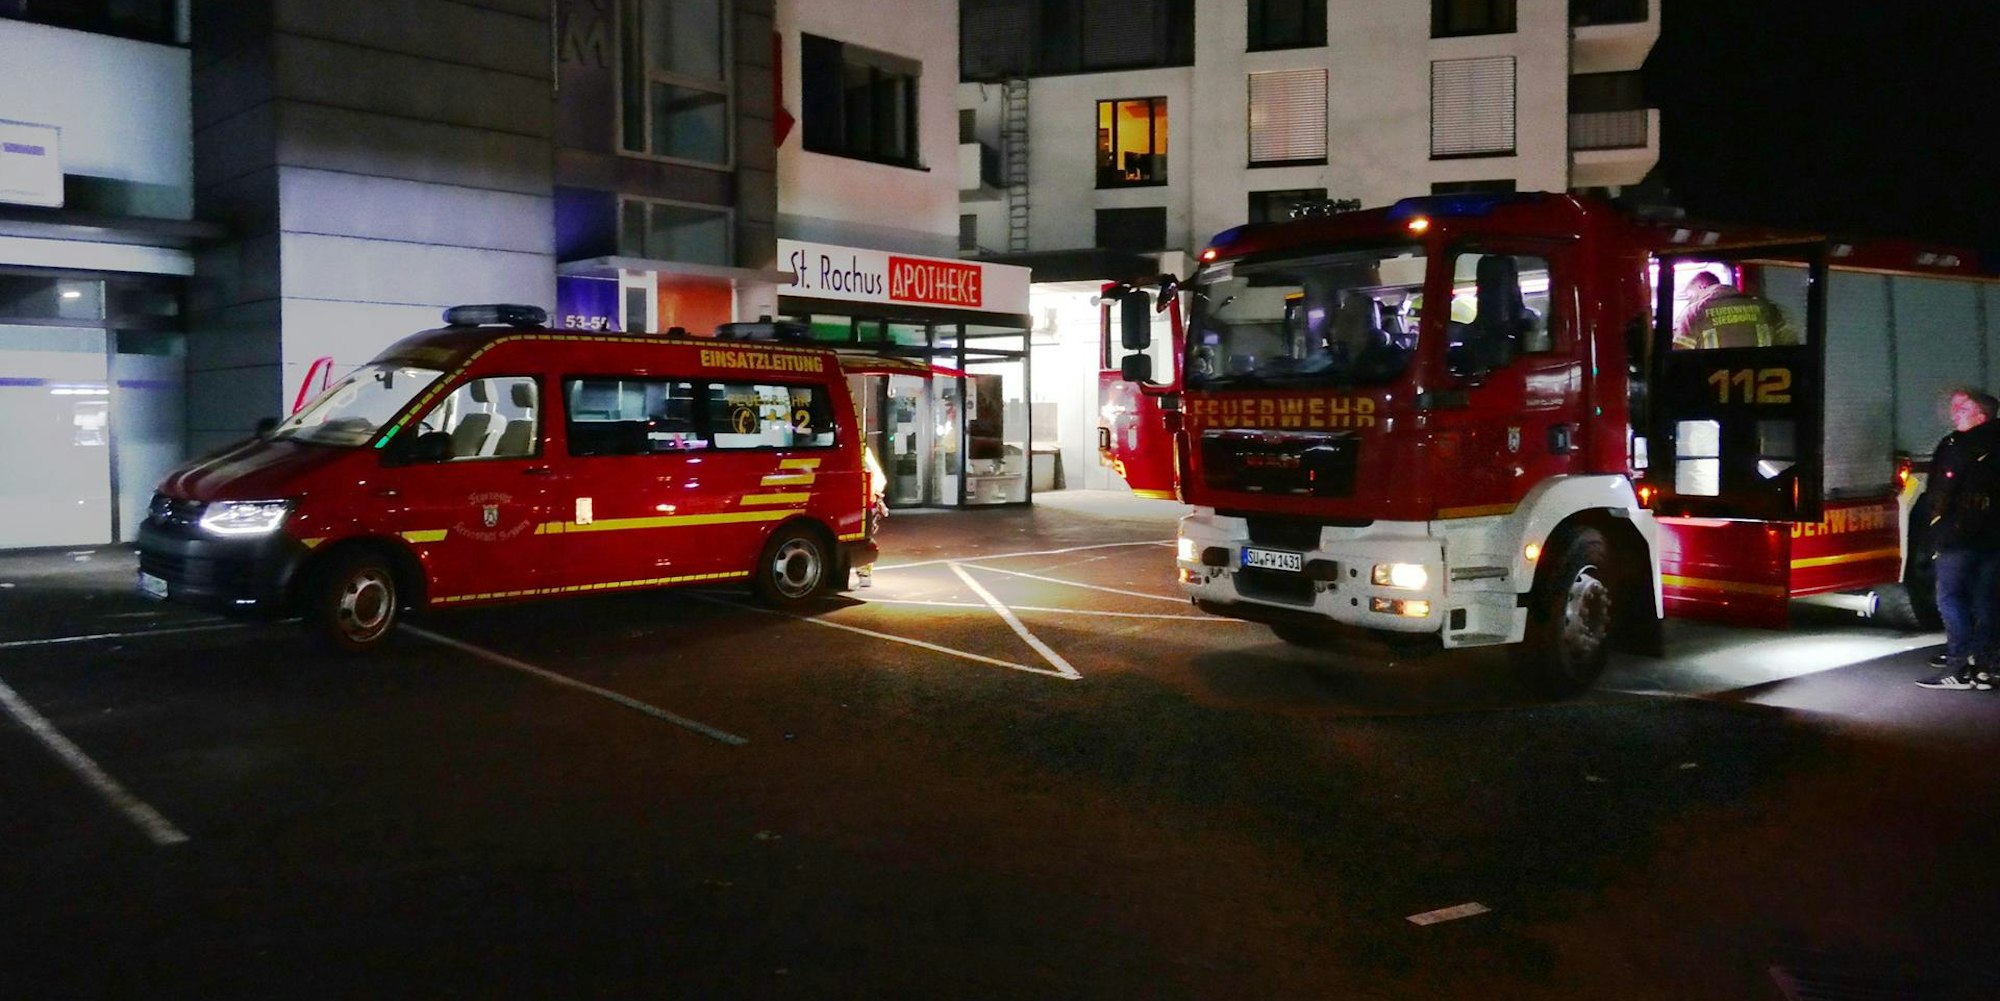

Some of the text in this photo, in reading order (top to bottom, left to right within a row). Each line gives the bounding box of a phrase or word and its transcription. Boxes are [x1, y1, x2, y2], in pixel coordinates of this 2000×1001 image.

[791, 250, 978, 303] St. Rochus APOTHEKE
[700, 349, 823, 372] EINSATZLEITUNG
[1708, 367, 1792, 404] 112
[1194, 397, 1375, 427] FEUERWEHR
